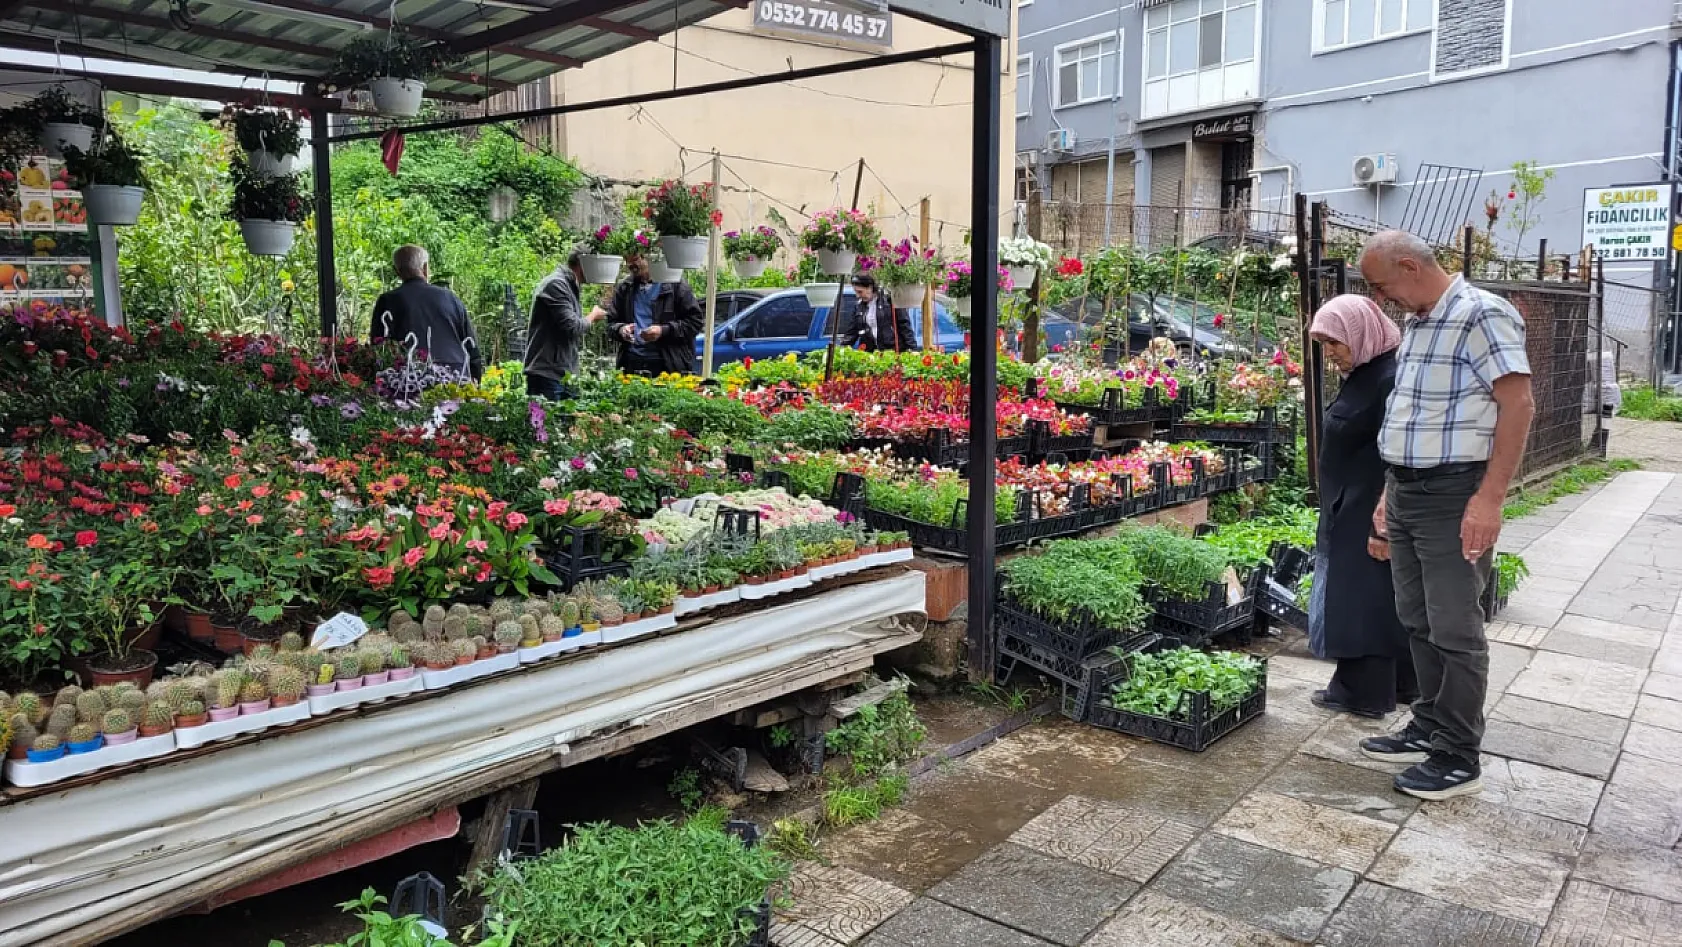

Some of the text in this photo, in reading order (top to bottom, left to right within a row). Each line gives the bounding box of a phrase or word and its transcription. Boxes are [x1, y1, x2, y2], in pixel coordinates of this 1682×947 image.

[760, 1, 888, 38] 0532 774 45 37
[1195, 120, 1229, 135] Bulut
[1599, 189, 1658, 207] ÇAKIR
[1600, 236, 1651, 246] Harun ÇAKIR
[1613, 248, 1631, 258] 681
[1636, 247, 1649, 257] 78
[1652, 246, 1665, 256] 50
